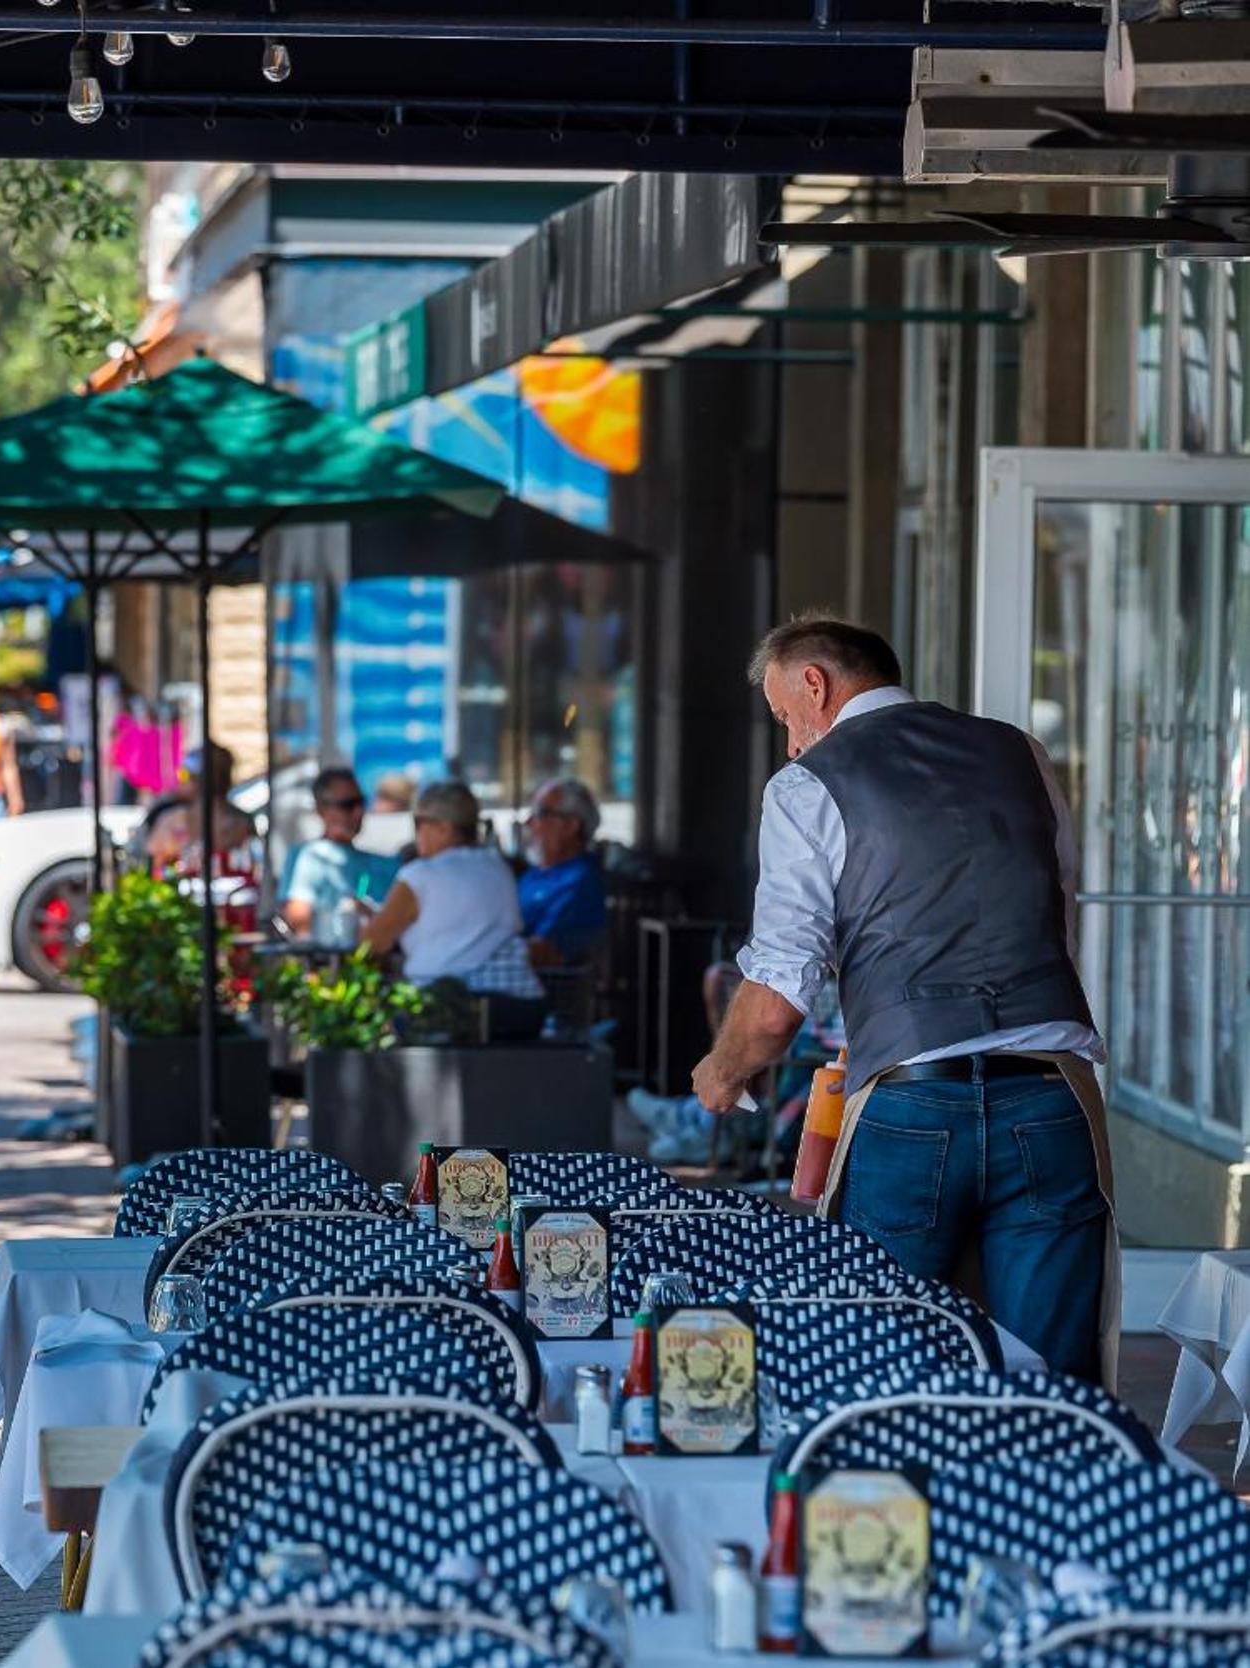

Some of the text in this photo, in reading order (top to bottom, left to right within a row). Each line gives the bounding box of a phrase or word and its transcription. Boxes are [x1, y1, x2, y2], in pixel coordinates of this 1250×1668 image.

[444, 1162, 503, 1174] BRUNCH
[533, 1233, 599, 1247] BRUNCH
[665, 1333, 745, 1349] BRUNCH
